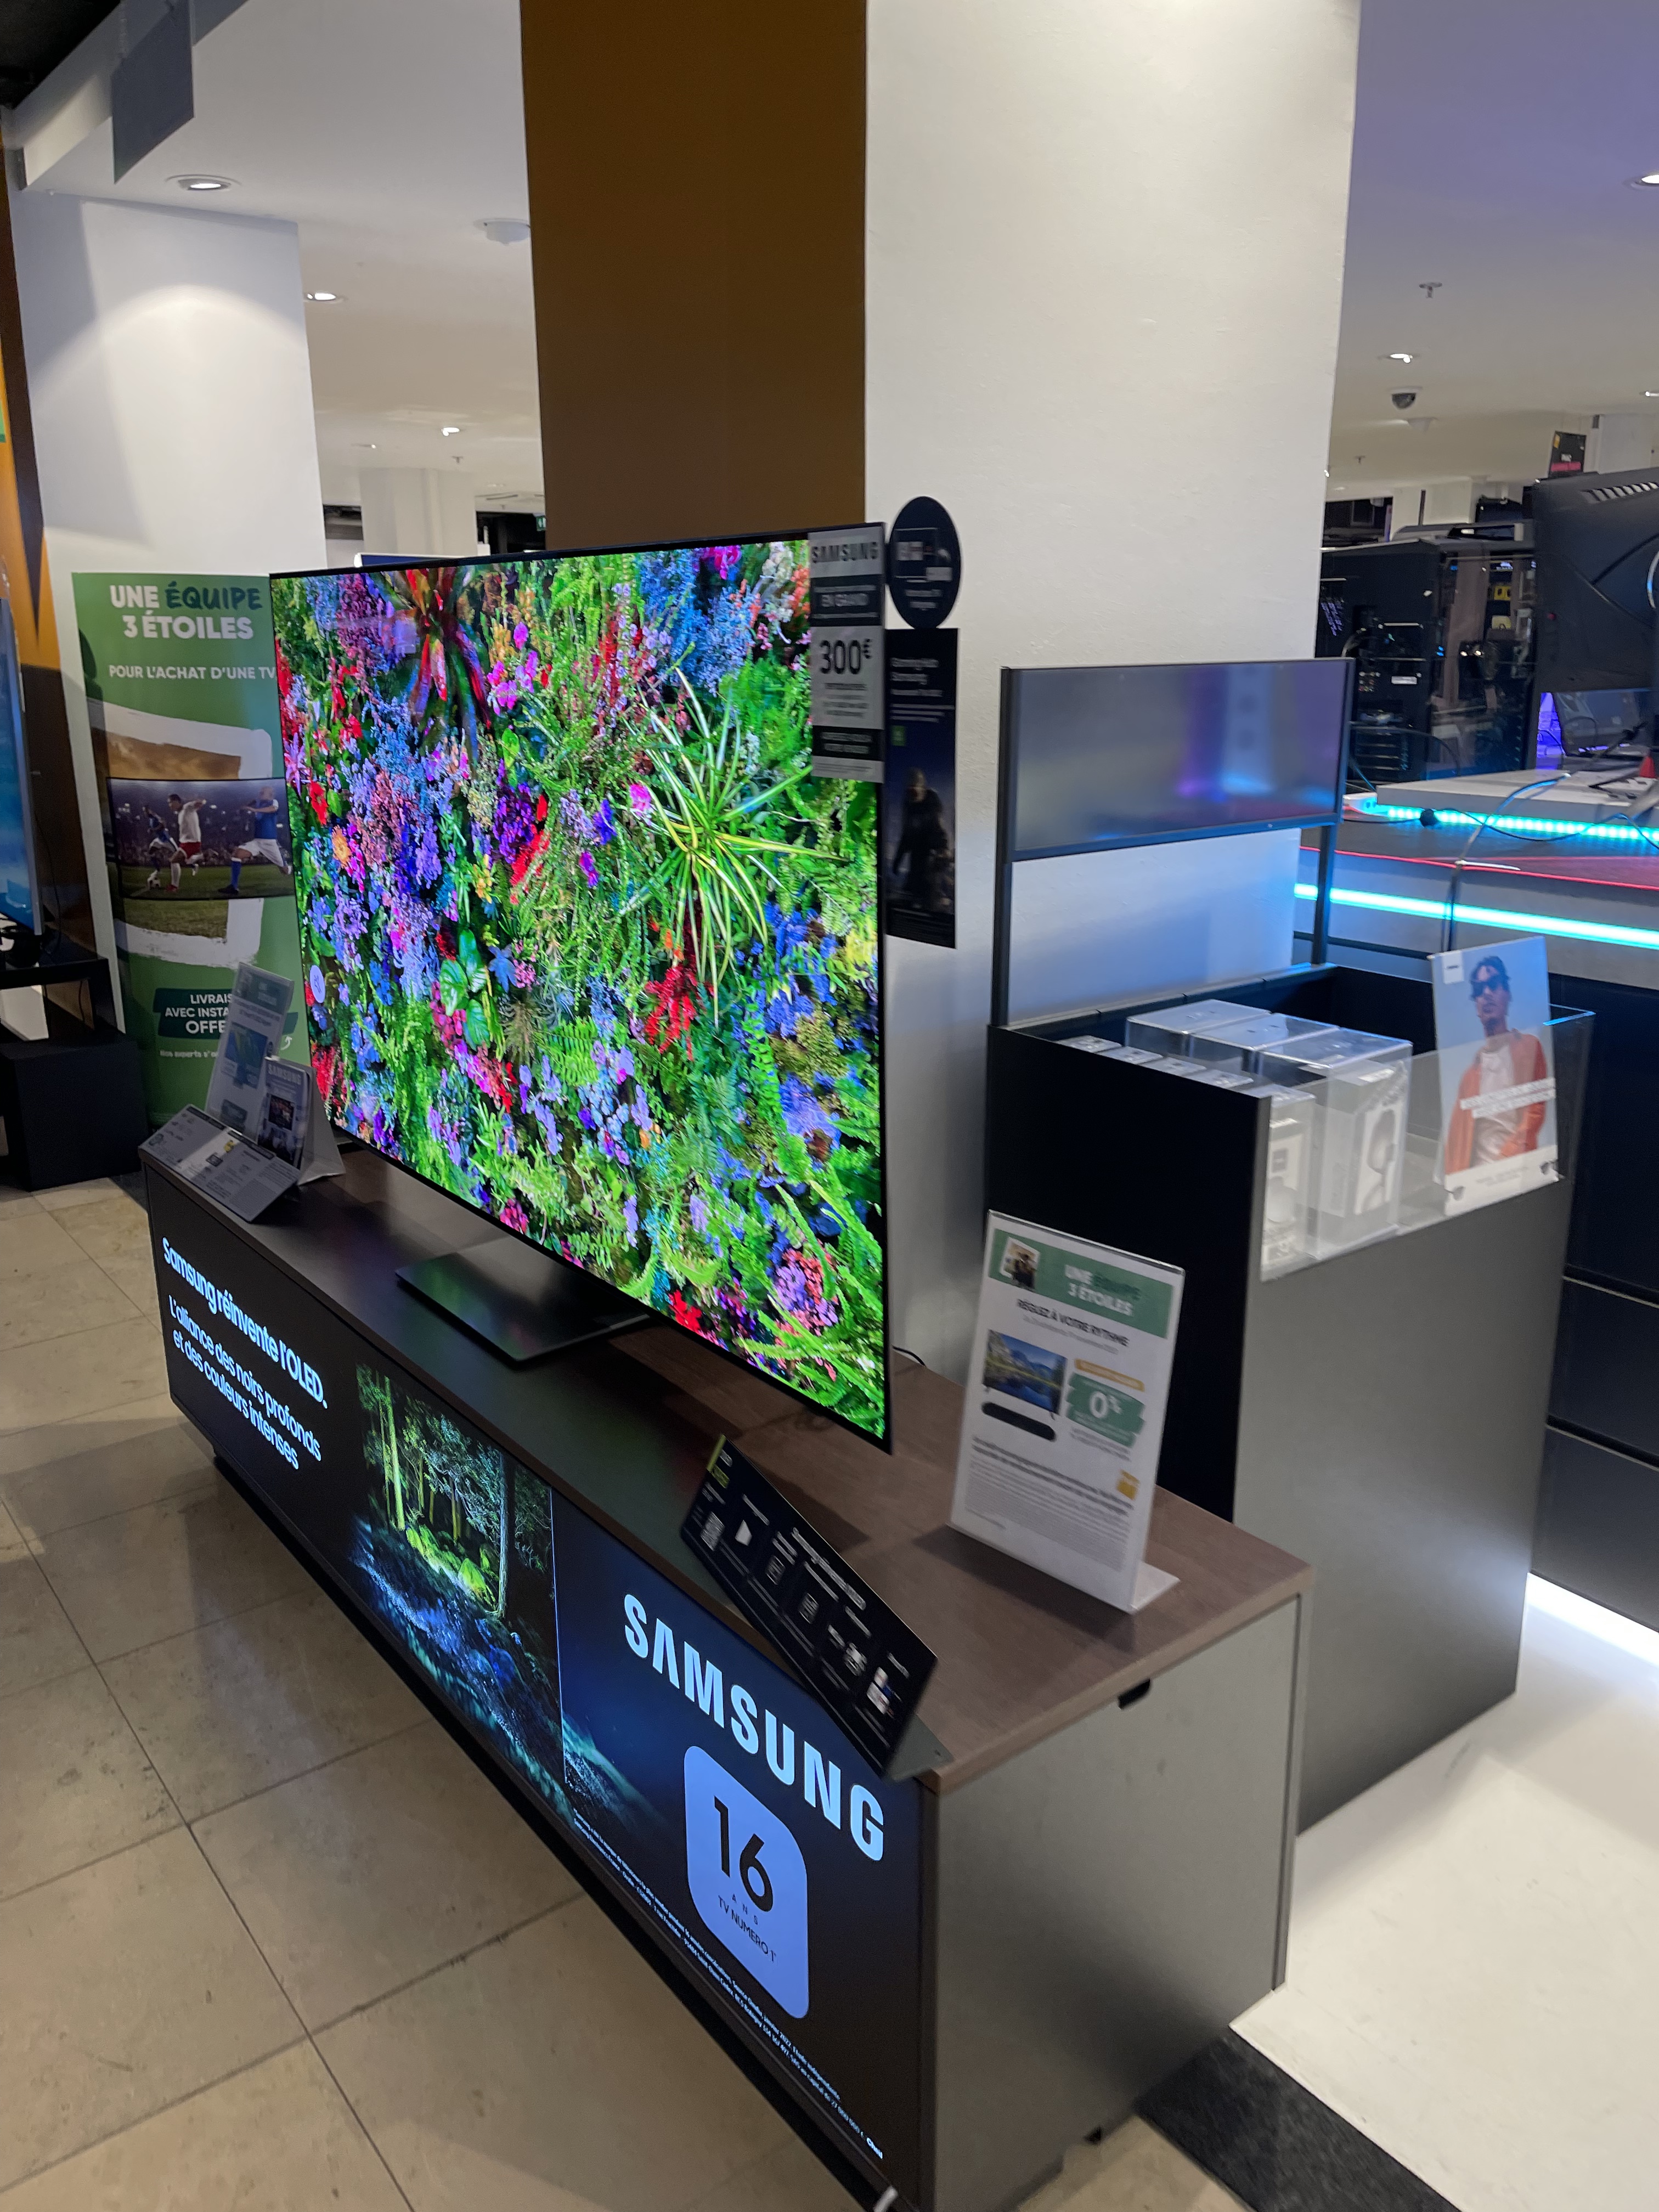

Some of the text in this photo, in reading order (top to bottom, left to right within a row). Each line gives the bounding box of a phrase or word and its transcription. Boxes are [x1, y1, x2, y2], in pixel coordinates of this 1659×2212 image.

[110, 581, 263, 611] UNE ÉQUIPE
[122, 609, 254, 640] 3 ÉTOILES
[109, 664, 143, 679] POUR
[146, 665, 205, 680] L'ACHAT
[210, 666, 256, 680] D'UNE
[819, 638, 873, 675] 300€
[165, 1007, 196, 1018] AVEC
[162, 1237, 216, 1314] Samsung
[216, 1289, 279, 1363] réinvente
[168, 1294, 322, 1462] L'alliance des noirs profonds
[173, 1329, 300, 1470] et des couleurs intenses
[623, 1593, 885, 1862] SAMSUNG
[713, 1795, 773, 1912] 16
[718, 1894, 730, 1915] TV
[730, 1908, 769, 1955] NUMERO
